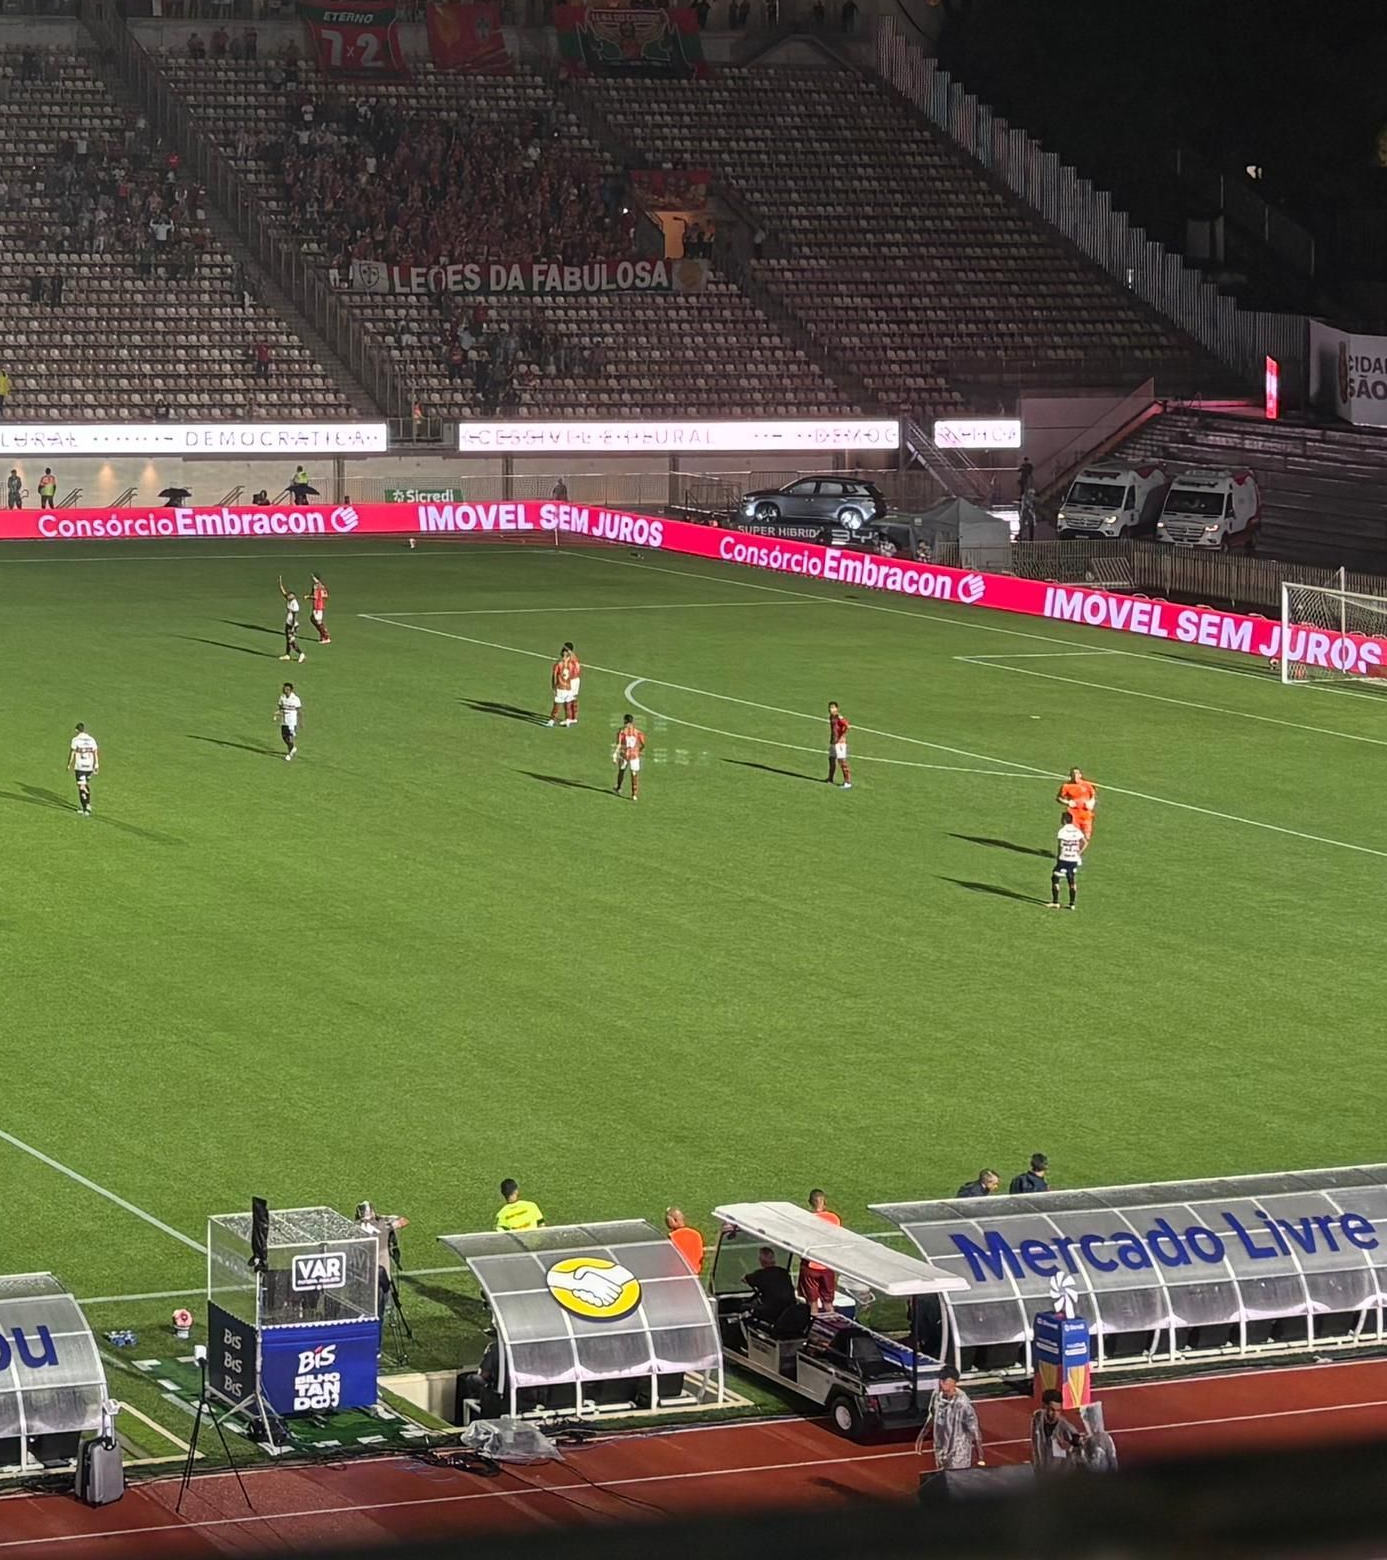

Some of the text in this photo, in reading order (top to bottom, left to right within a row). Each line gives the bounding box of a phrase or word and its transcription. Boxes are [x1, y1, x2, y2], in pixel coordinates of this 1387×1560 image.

[322, 11, 374, 24] ETERNO
[490, 263, 525, 292] DA
[531, 261, 669, 292] FABULOSA
[406, 489, 454, 503] Sicredi
[38, 508, 325, 538] Consórcio Embracon
[539, 502, 589, 534] SEM
[591, 511, 664, 547] JUROS
[738, 525, 775, 536] SUPER
[719, 535, 952, 600] Consórcio Embracon
[1176, 609, 1253, 653] SEM
[1258, 625, 1382, 674] JUROS
[949, 1209, 1377, 1284] Mercado Livre
[297, 1257, 341, 1280] VAR
[294, 1381, 341, 1397] TAN
